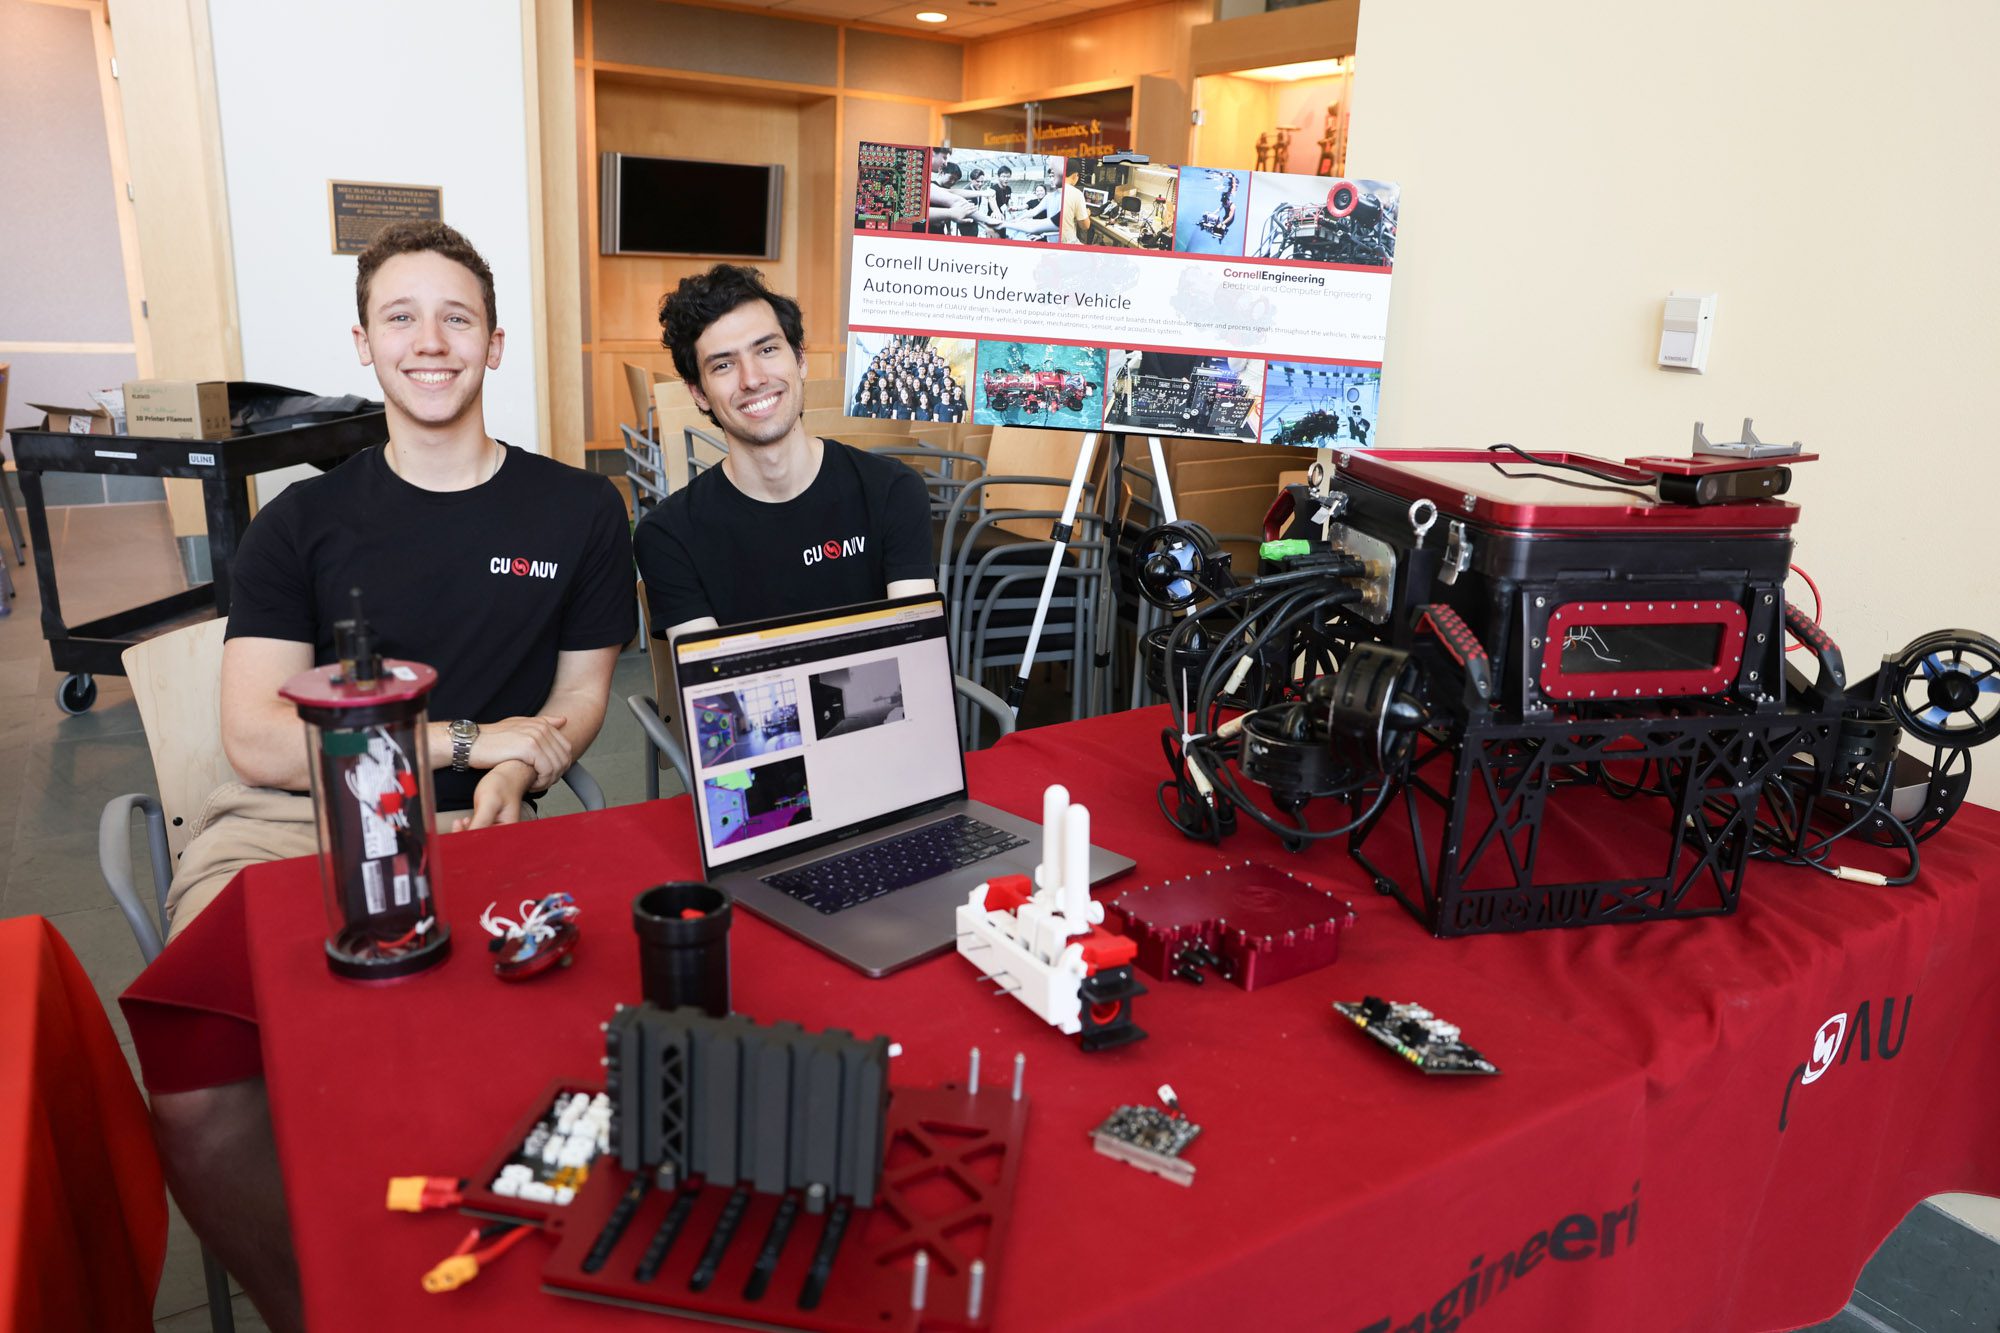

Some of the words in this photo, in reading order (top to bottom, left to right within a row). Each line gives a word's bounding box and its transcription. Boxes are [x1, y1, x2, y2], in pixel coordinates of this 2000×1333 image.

[1090, 119, 1101, 134] &
[1079, 141, 1115, 157] Devices
[865, 253, 922, 271] Cornell
[928, 257, 1008, 280] University
[1223, 268, 1325, 287] CornellEngineering
[863, 278, 968, 298] Autonomous
[973, 285, 1070, 305] Underwater
[1074, 292, 1131, 309] Vehicle
[1223, 281, 1260, 291] Electrical
[1262, 284, 1278, 293] and
[1280, 285, 1322, 296] Computer
[1324, 289, 1372, 300] Engineering
[861, 307, 888, 316] improve
[889, 308, 900, 316] the
[900, 310, 931, 319] efficiency
[945, 312, 974, 321] reliability
[1114, 324, 1127, 332] and
[1127, 326, 1156, 334] acoustics
[875, 299, 904, 307] Electrical
[1015, 308, 1027, 316] and
[1028, 310, 1056, 319] populate
[1081, 312, 1104, 321] printed
[1105, 314, 1125, 322] circuit
[1126, 316, 1148, 324] boards
[1148, 317, 1161, 325] that
[1162, 318, 1193, 327] distribute
[1193, 321, 1213, 330] power
[1228, 323, 1252, 332] process
[1252, 324, 1273, 334] signals
[1275, 327, 1310, 336] throughout
[1311, 328, 1322, 336] the
[1350, 332, 1361, 340] We
[1362, 333, 1378, 341] work
[166, 415, 193, 423] Filament
[190, 455, 213, 464] ULINE
[490, 557, 511, 574] CU
